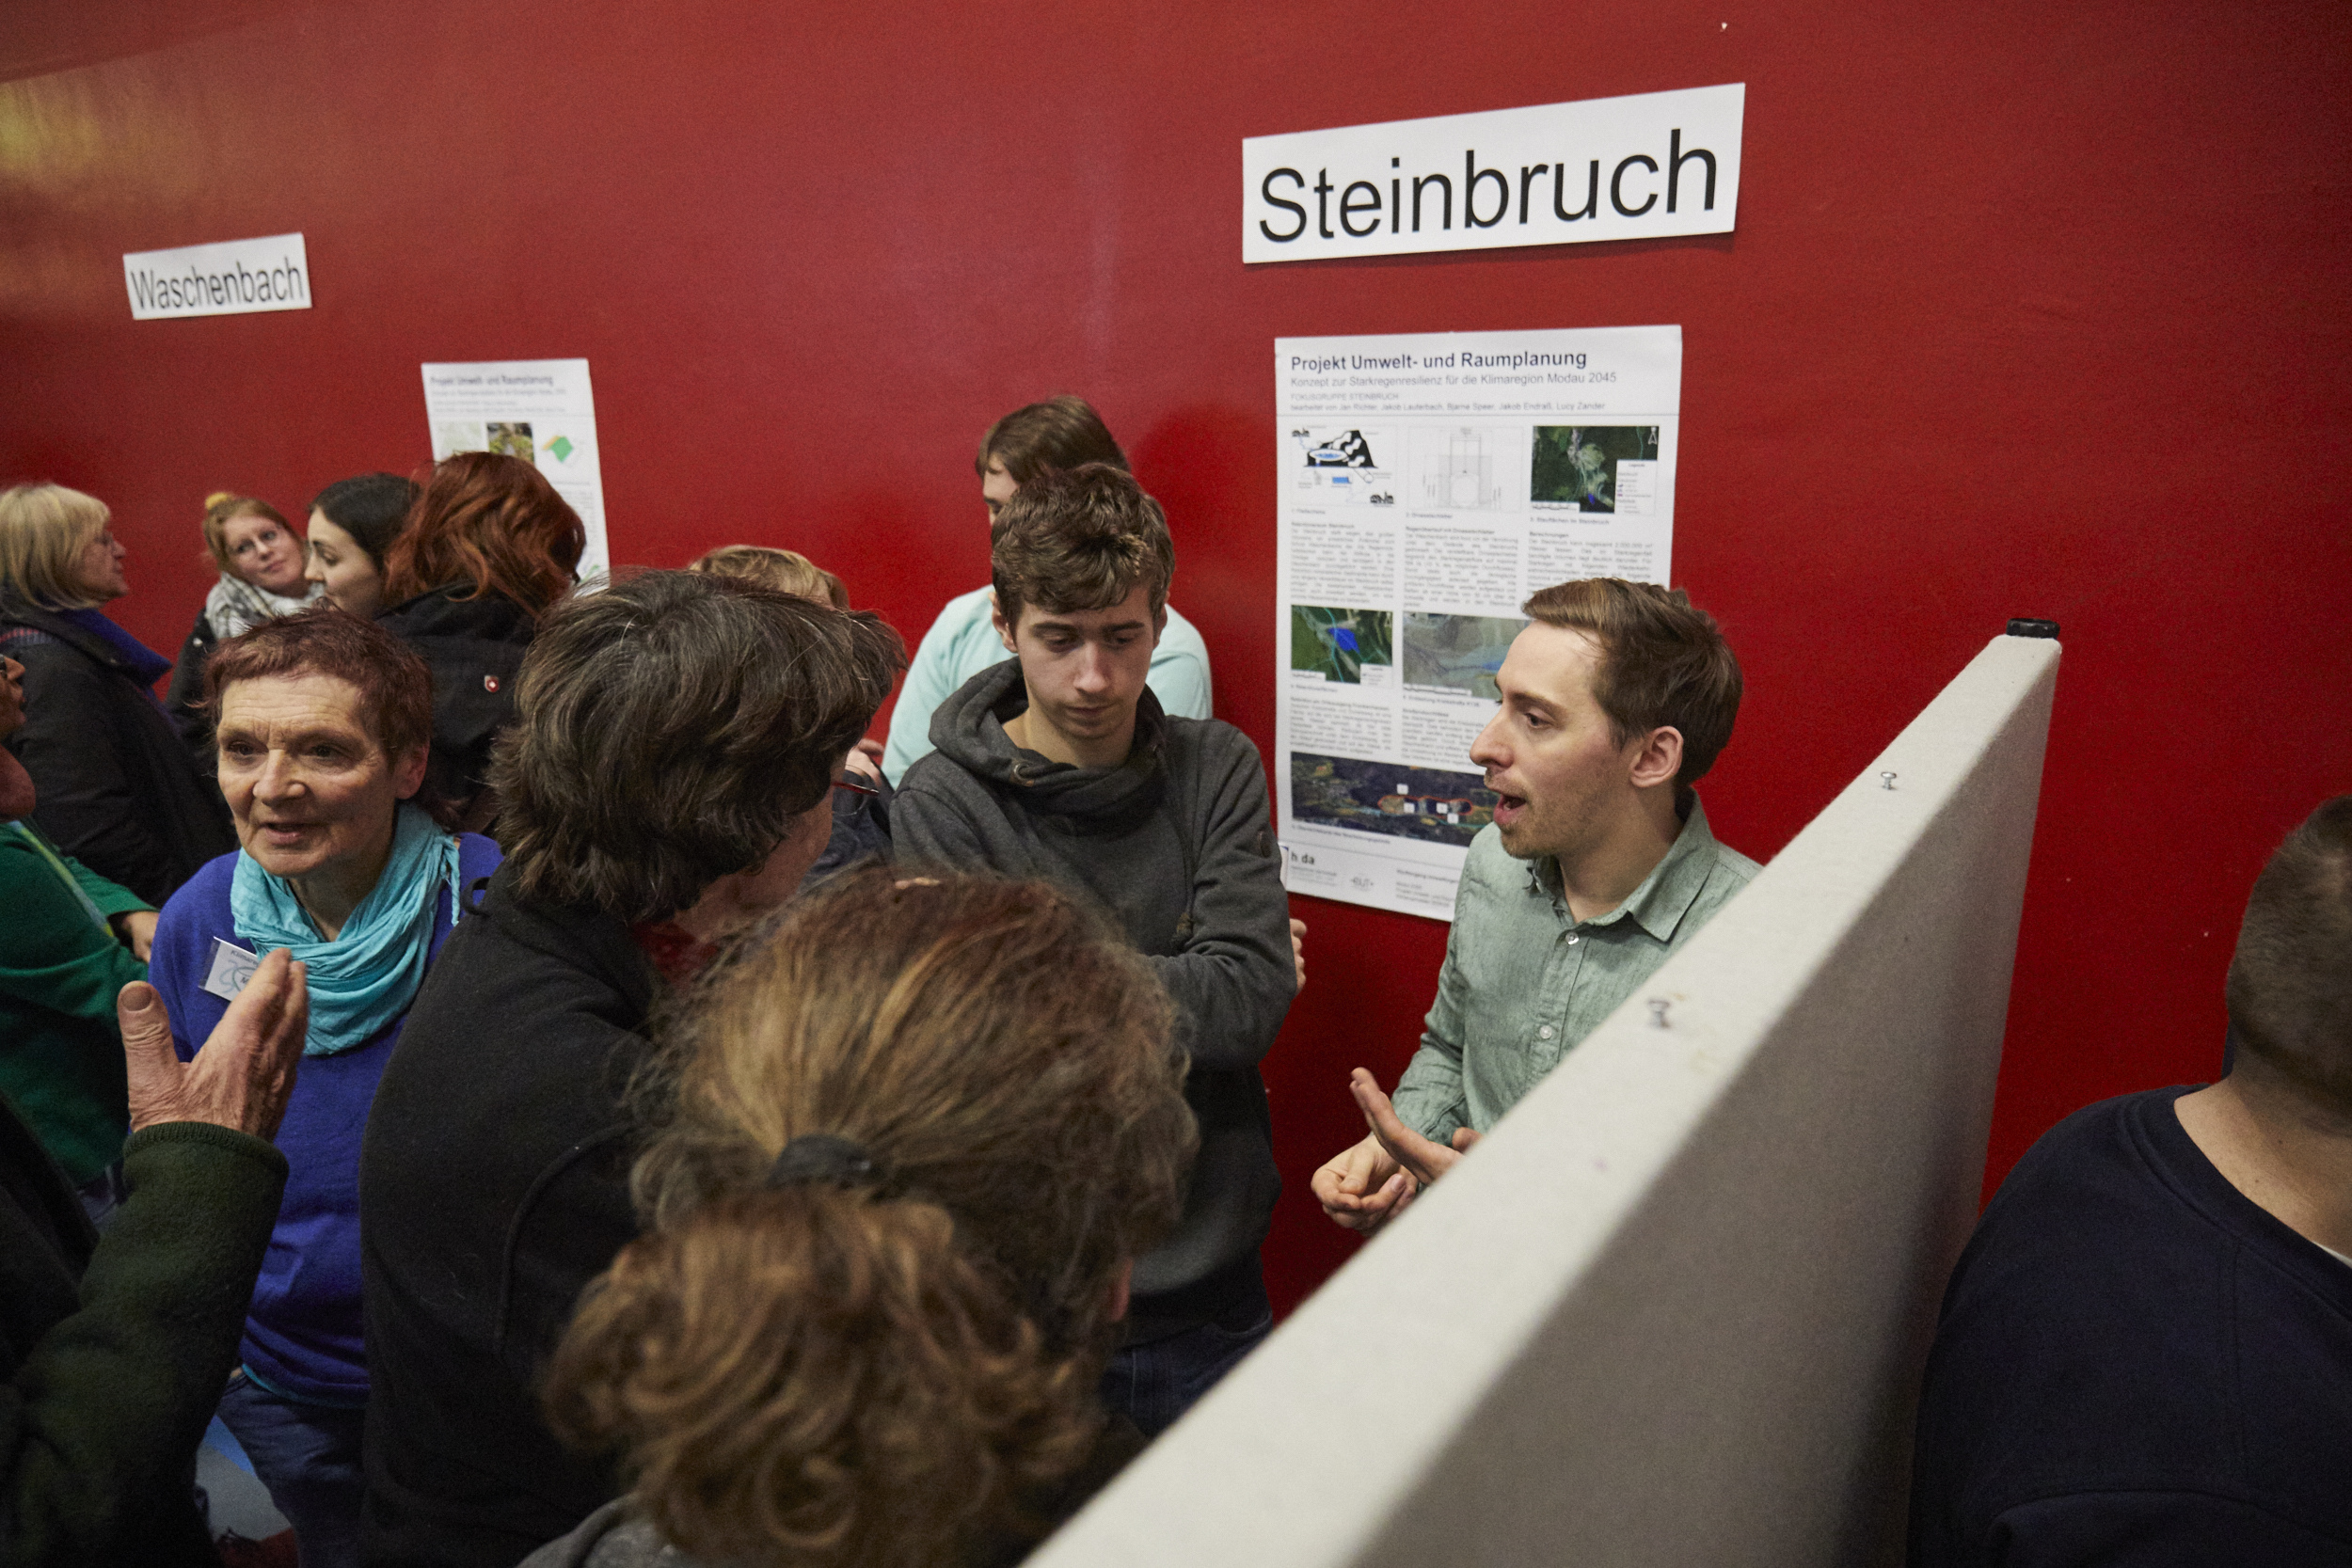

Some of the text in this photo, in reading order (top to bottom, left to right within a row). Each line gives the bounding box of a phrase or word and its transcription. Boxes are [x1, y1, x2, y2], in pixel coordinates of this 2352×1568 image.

[1259, 128, 1717, 243] Steinbruch
[130, 256, 304, 309] Waschenbach
[1291, 351, 1587, 374] Projekt Umwelt- und Raumplanung
[1291, 377, 1328, 388] Konzept
[1349, 375, 1442, 388] Starkregenresilienz
[1445, 375, 1458, 385] für
[1461, 373, 1477, 385] die
[1481, 374, 1544, 387] Klimaregion
[1547, 372, 1585, 384] Modau
[1588, 372, 1617, 383] 2045
[1349, 392, 1399, 401] STEINBRUCH
[1380, 403, 1402, 411] Jakob
[1499, 402, 1521, 411] Jakob
[1556, 402, 1575, 411] Lucy
